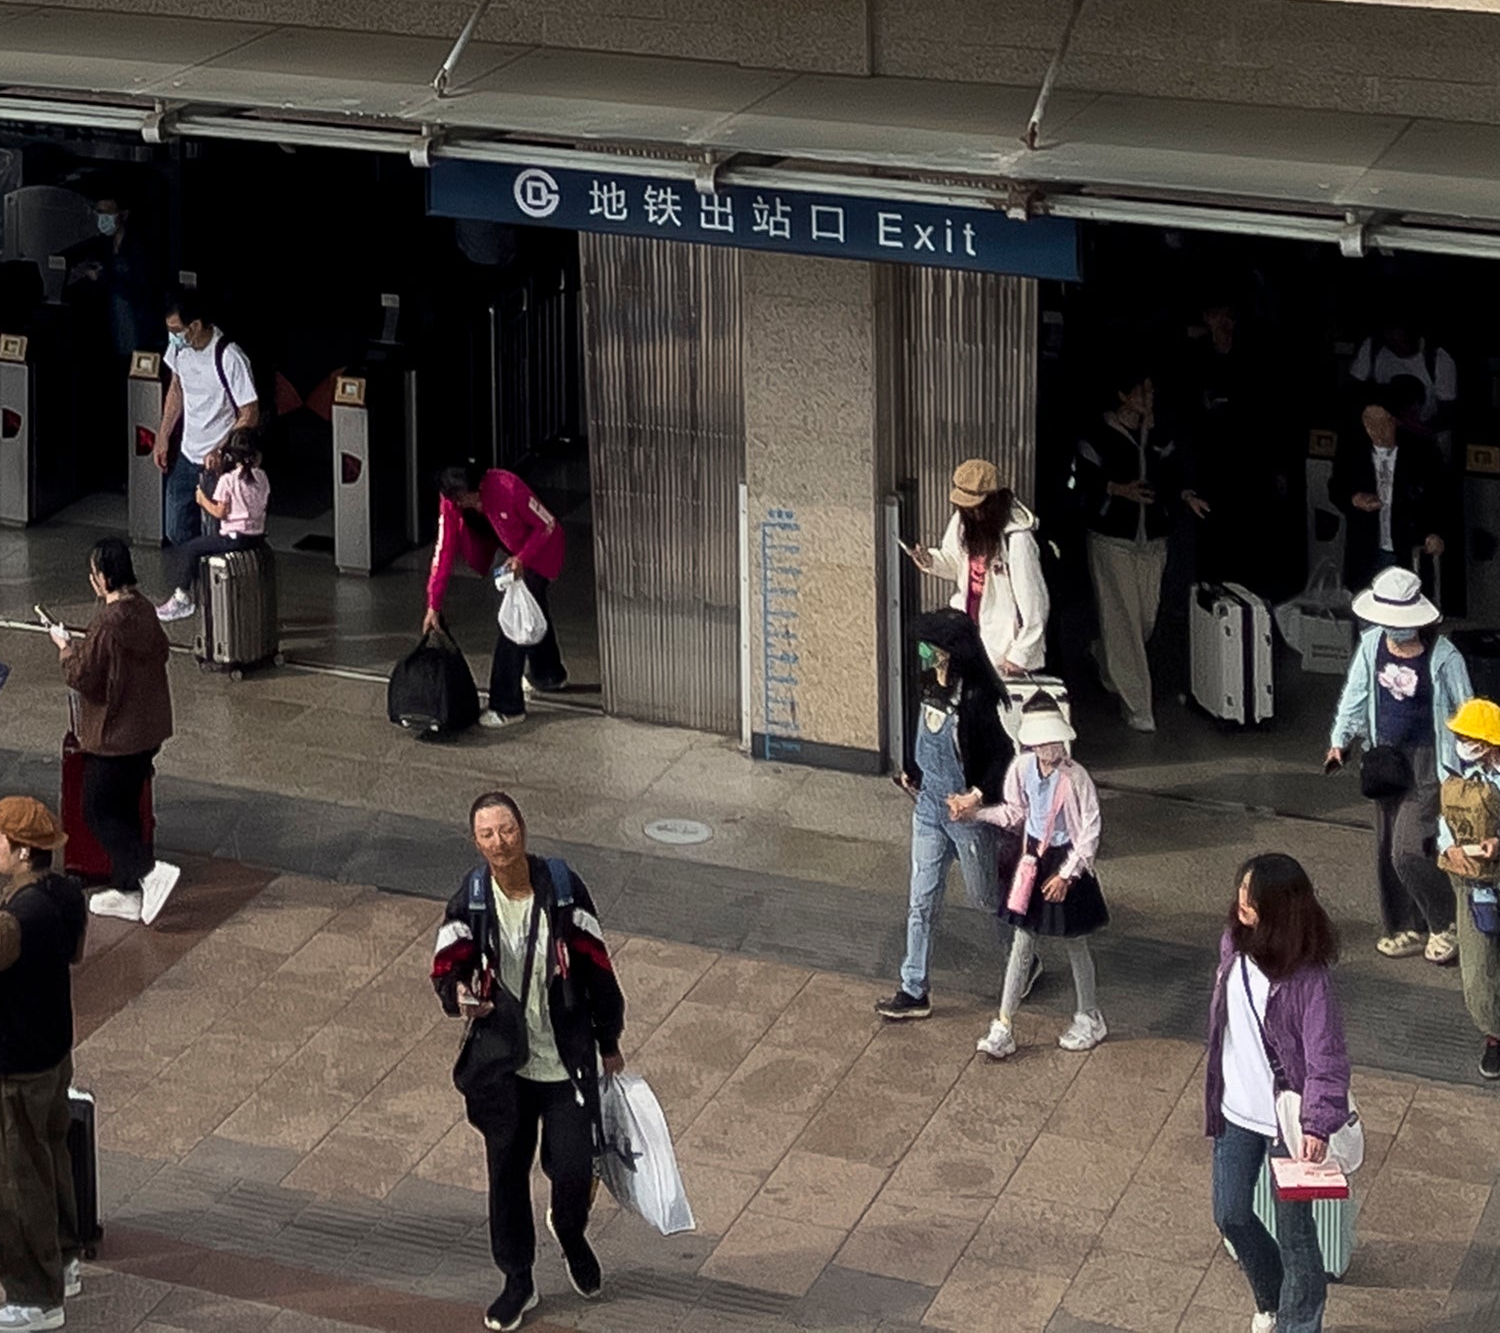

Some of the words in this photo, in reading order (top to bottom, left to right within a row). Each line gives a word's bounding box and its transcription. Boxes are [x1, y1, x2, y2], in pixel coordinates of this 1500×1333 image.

[589, 179, 846, 243] 地铁出站口
[877, 211, 977, 257] Exit
